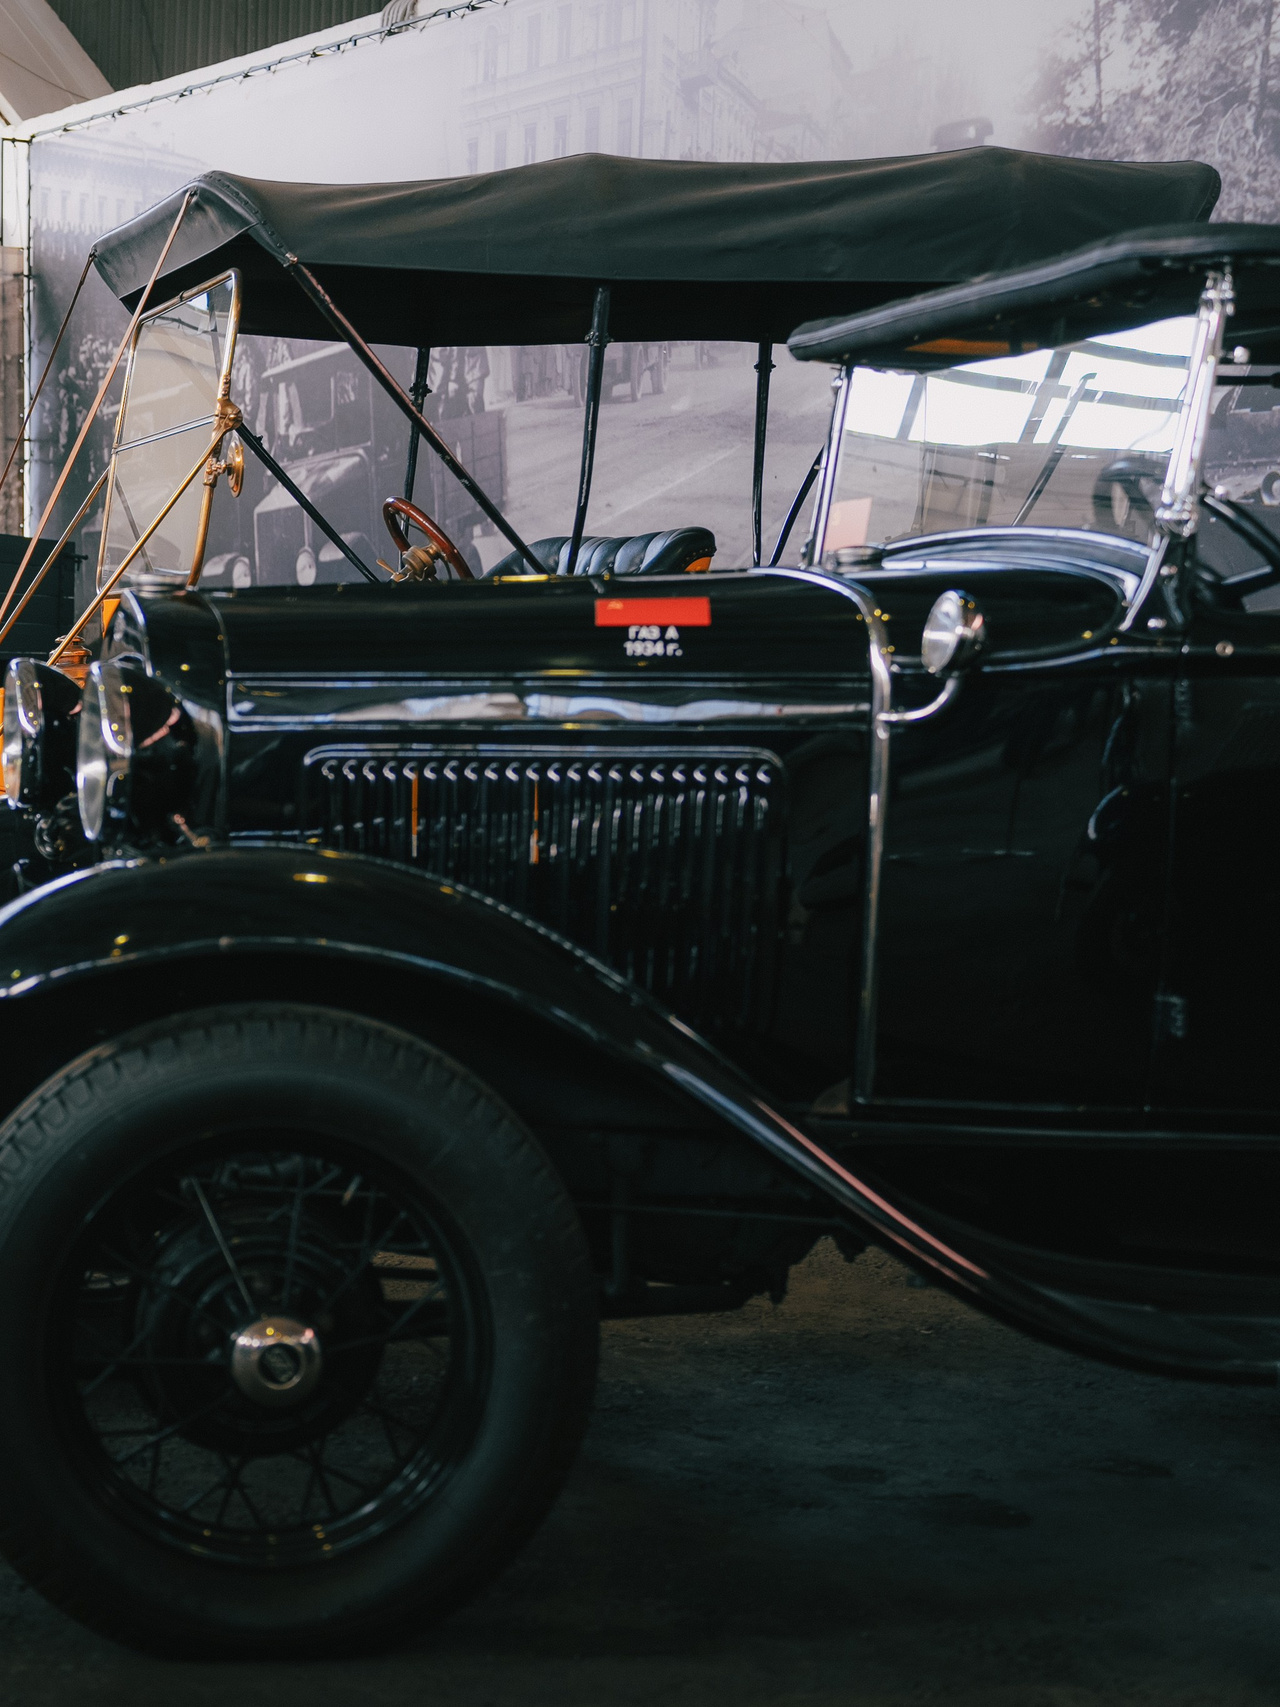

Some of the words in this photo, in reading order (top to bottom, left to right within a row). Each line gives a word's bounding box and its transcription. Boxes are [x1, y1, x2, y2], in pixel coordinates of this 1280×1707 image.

[628, 625, 661, 640] ГАЗ
[665, 625, 680, 640] А
[623, 640, 665, 657] 1934
